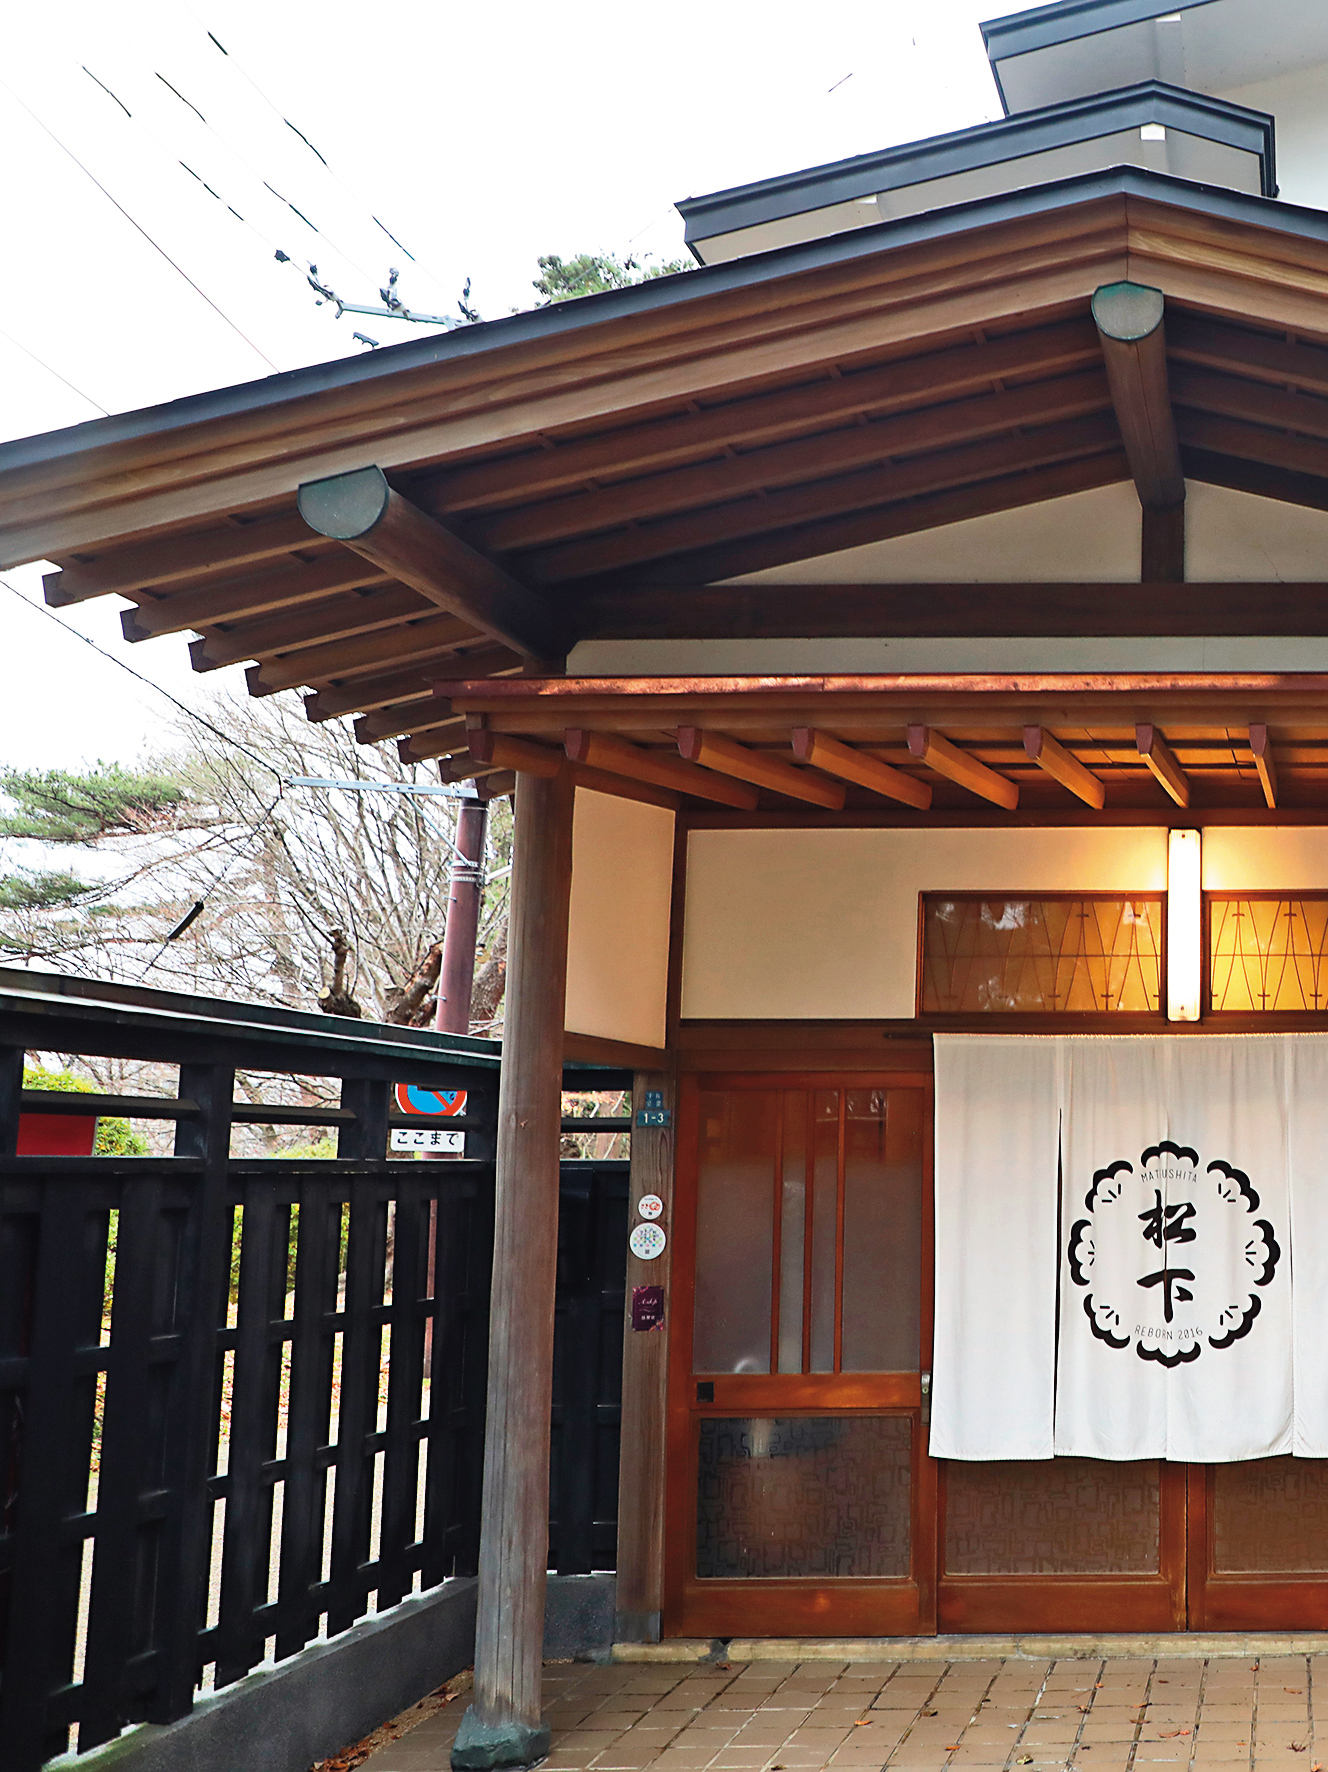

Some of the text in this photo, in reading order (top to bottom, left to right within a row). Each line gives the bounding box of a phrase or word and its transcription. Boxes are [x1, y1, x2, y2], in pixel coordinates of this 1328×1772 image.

[644, 1112, 664, 1124] 1-3
[397, 1130, 460, 1146] ここまで
[1136, 1188, 1198, 1324] 松下
[1134, 1324, 1204, 1340] REBORN 2016
